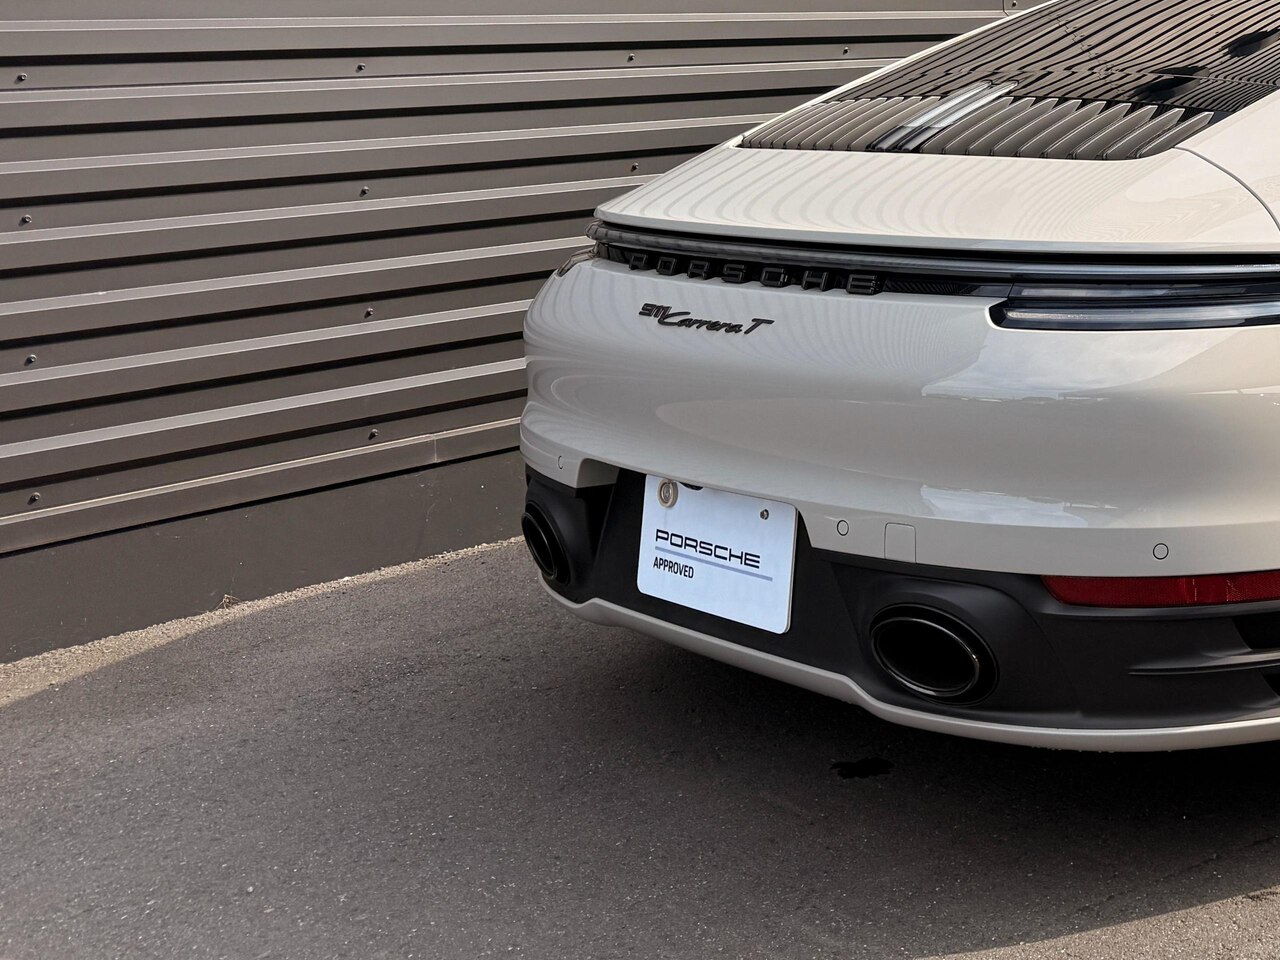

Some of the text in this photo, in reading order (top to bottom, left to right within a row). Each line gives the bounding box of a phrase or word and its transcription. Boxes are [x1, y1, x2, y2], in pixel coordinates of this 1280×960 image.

[629, 253, 881, 295] PORSCHE
[657, 311, 744, 334] Carrera
[743, 317, 775, 335] T
[656, 529, 761, 569] PORSCHE
[653, 556, 694, 578] APPROVED
